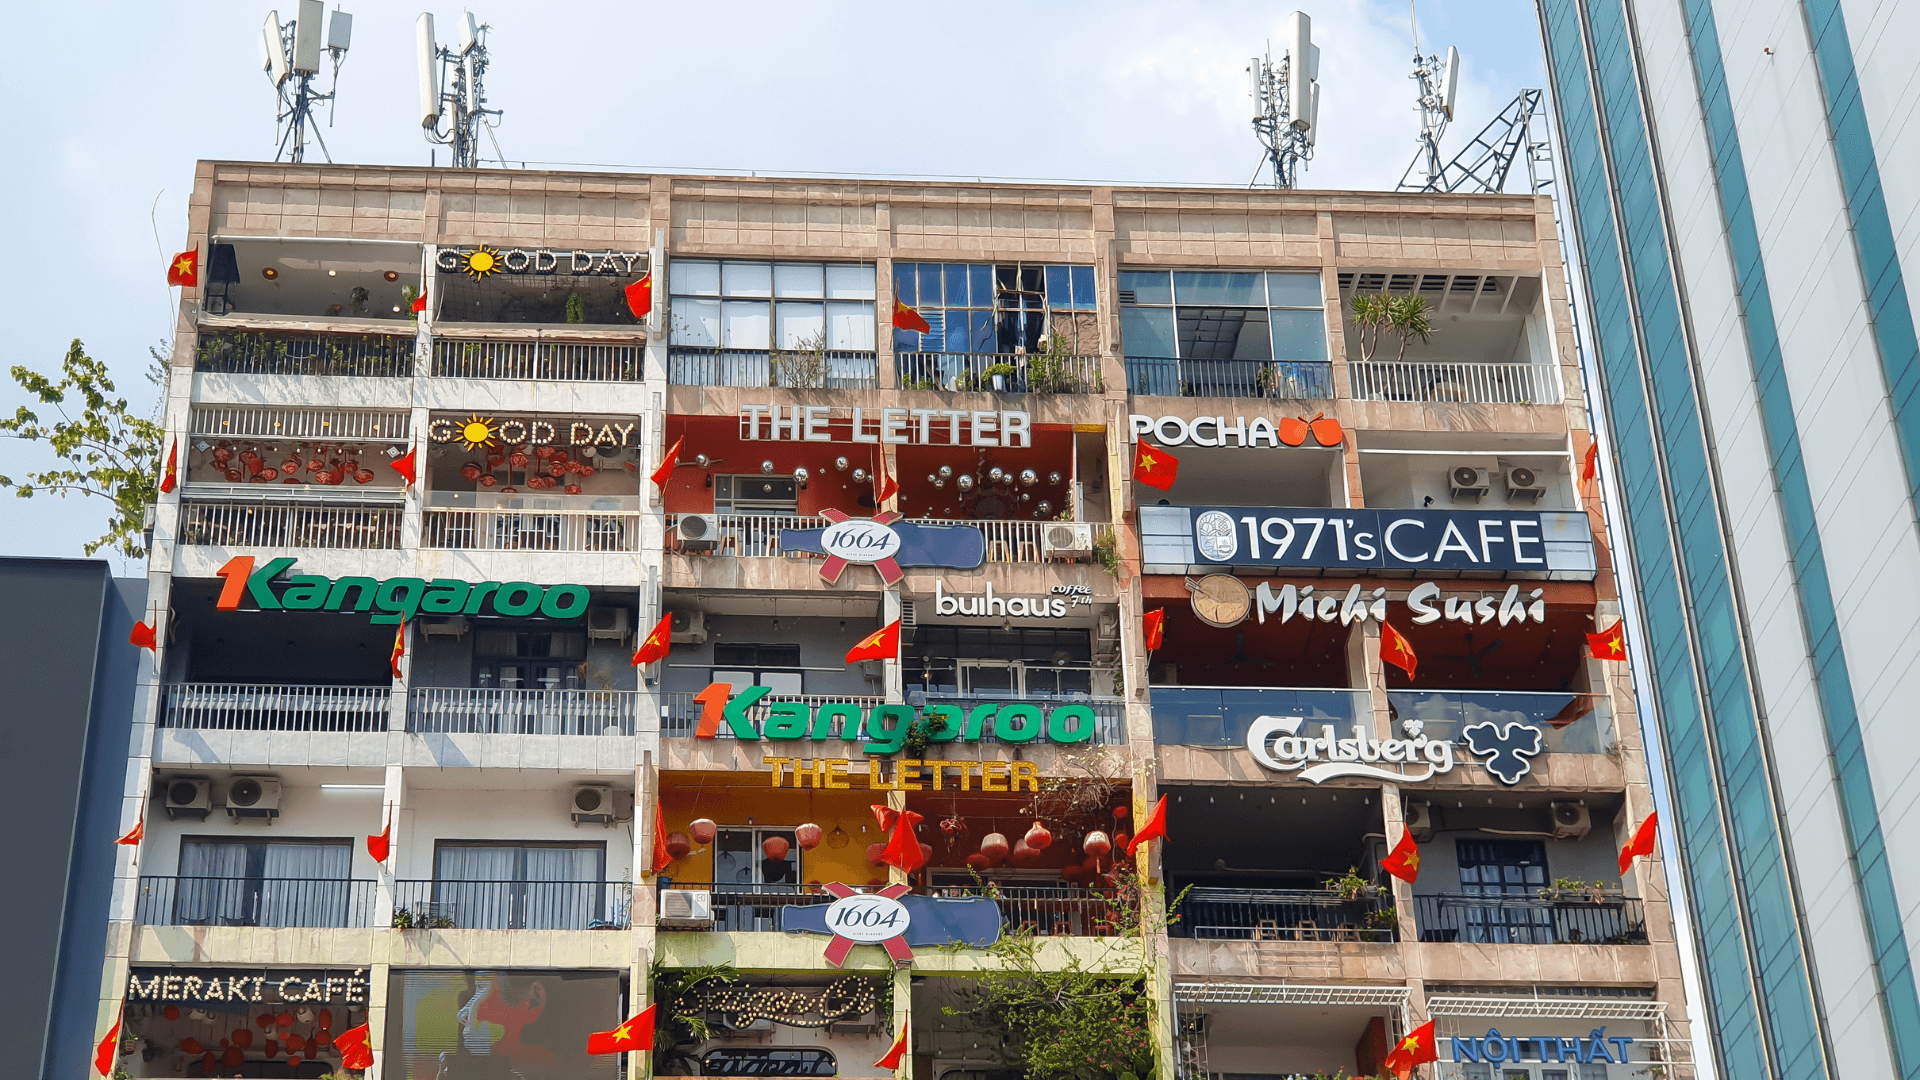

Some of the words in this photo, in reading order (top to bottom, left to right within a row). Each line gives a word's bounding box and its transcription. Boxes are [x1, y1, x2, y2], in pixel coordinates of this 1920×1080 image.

[571, 249, 641, 277] DAY
[571, 422, 634, 446] DAY
[740, 404, 832, 442] THE
[851, 405, 1031, 448] LETTER
[1129, 414, 1279, 449] POCHA
[830, 527, 894, 550] 1664
[1240, 516, 1377, 562] 1971's
[1383, 518, 1544, 565] CAFE
[1051, 584, 1092, 597] coffee
[1256, 581, 1387, 627] Michi
[1407, 582, 1546, 628] Sushi
[1246, 715, 1455, 784] Carlsberg
[763, 756, 850, 789] THE
[869, 757, 1039, 792] LETTER
[835, 904, 904, 928] 1664
[129, 974, 266, 1001] MERAKI
[278, 967, 366, 1002] CAFÉ
[1451, 1027, 1522, 1069] NỘI
